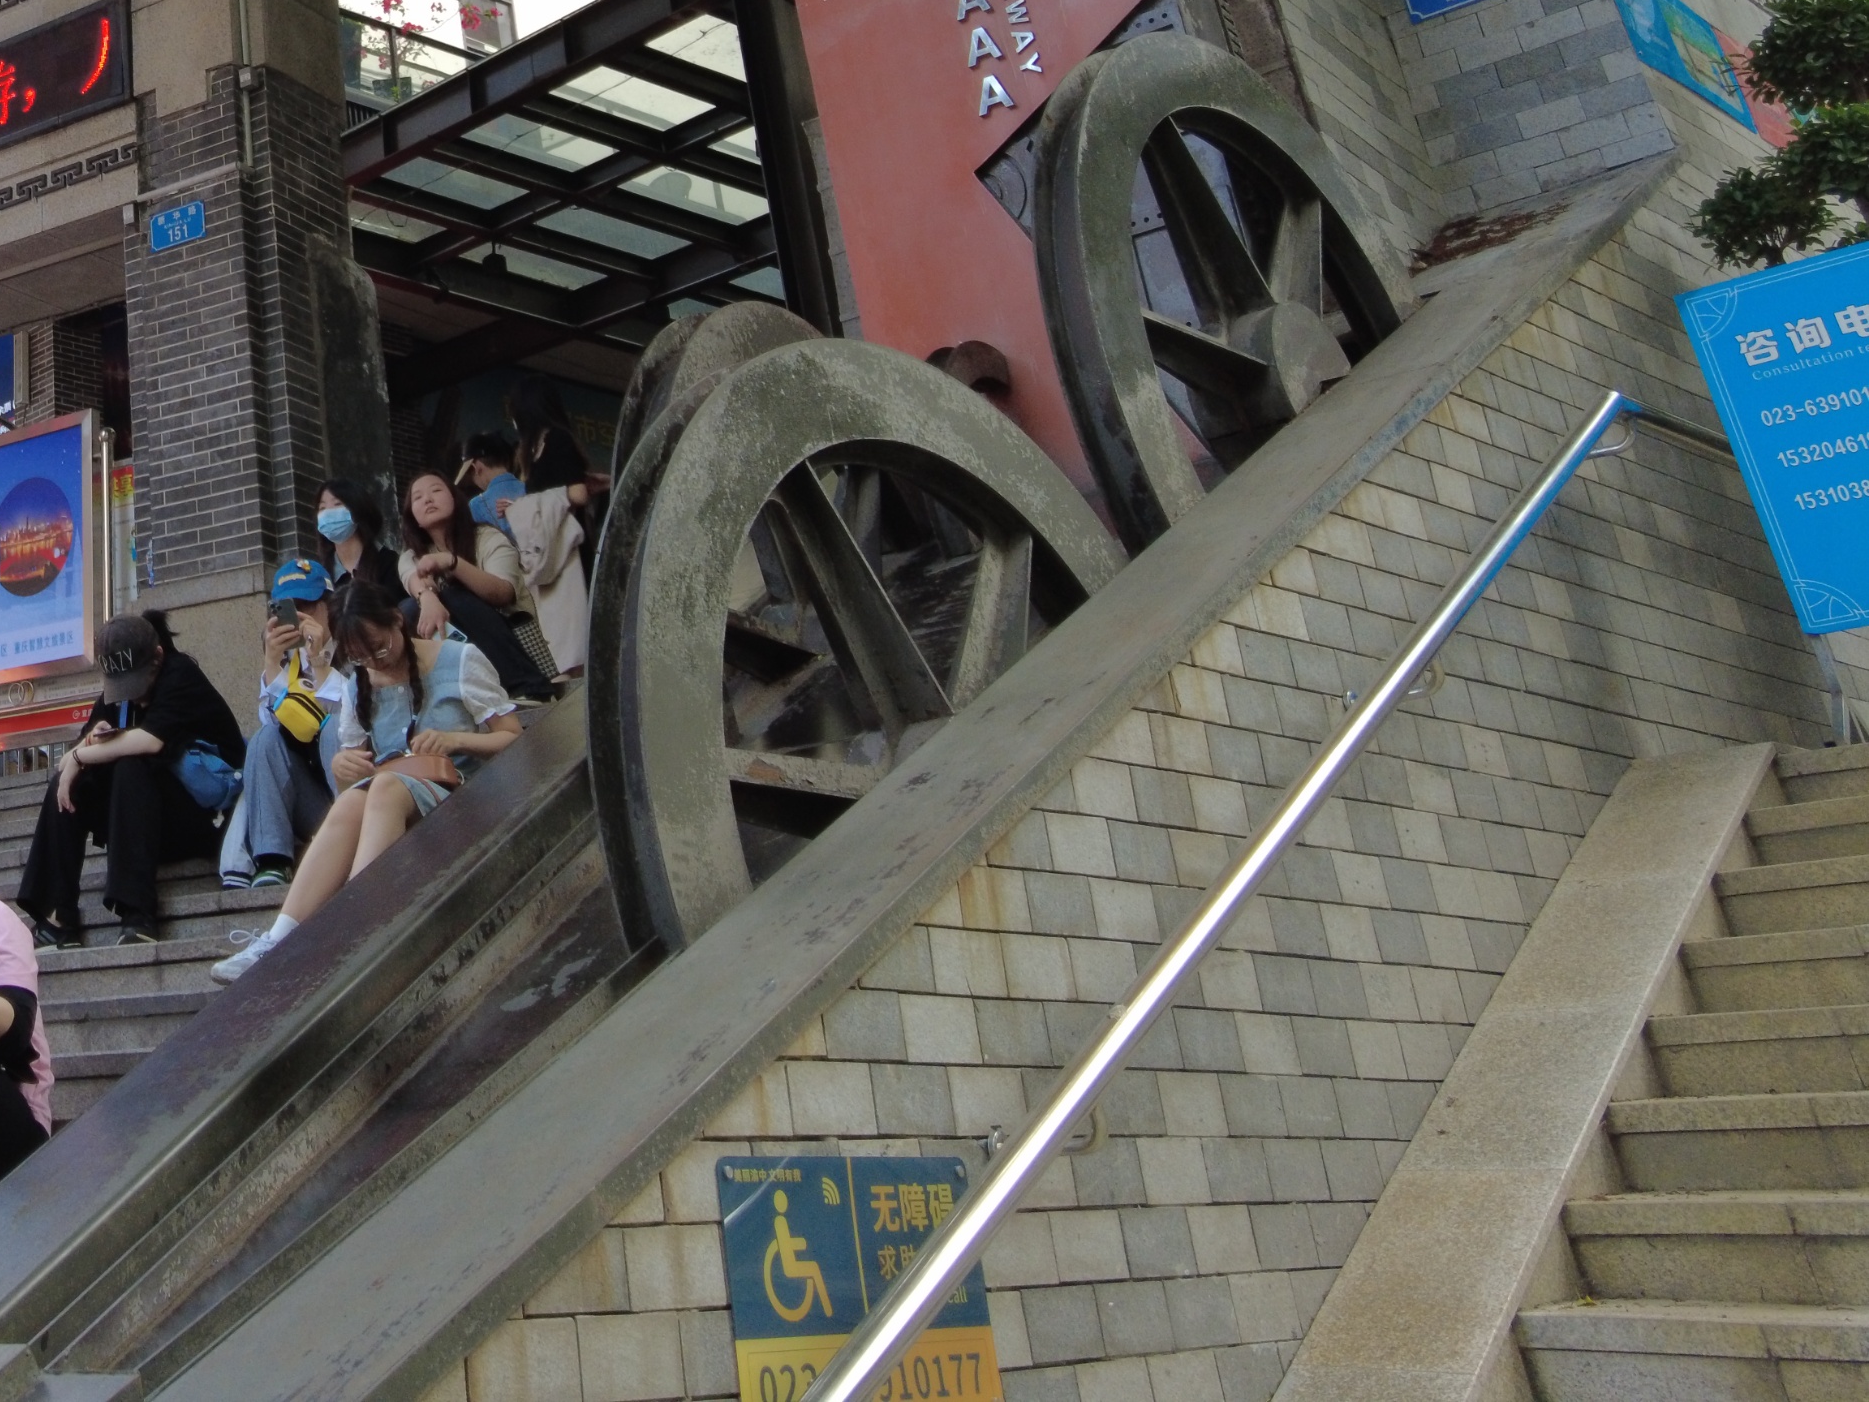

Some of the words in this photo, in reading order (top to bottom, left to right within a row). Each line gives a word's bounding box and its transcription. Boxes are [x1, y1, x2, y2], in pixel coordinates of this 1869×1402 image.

[167, 224, 189, 243] 151
[1734, 304, 1869, 367] 咨询电
[1752, 349, 1854, 381] Consultation
[1760, 386, 1869, 427] 023-639101
[1777, 430, 1869, 468] 15320461
[870, 1183, 954, 1233] 无障碍
